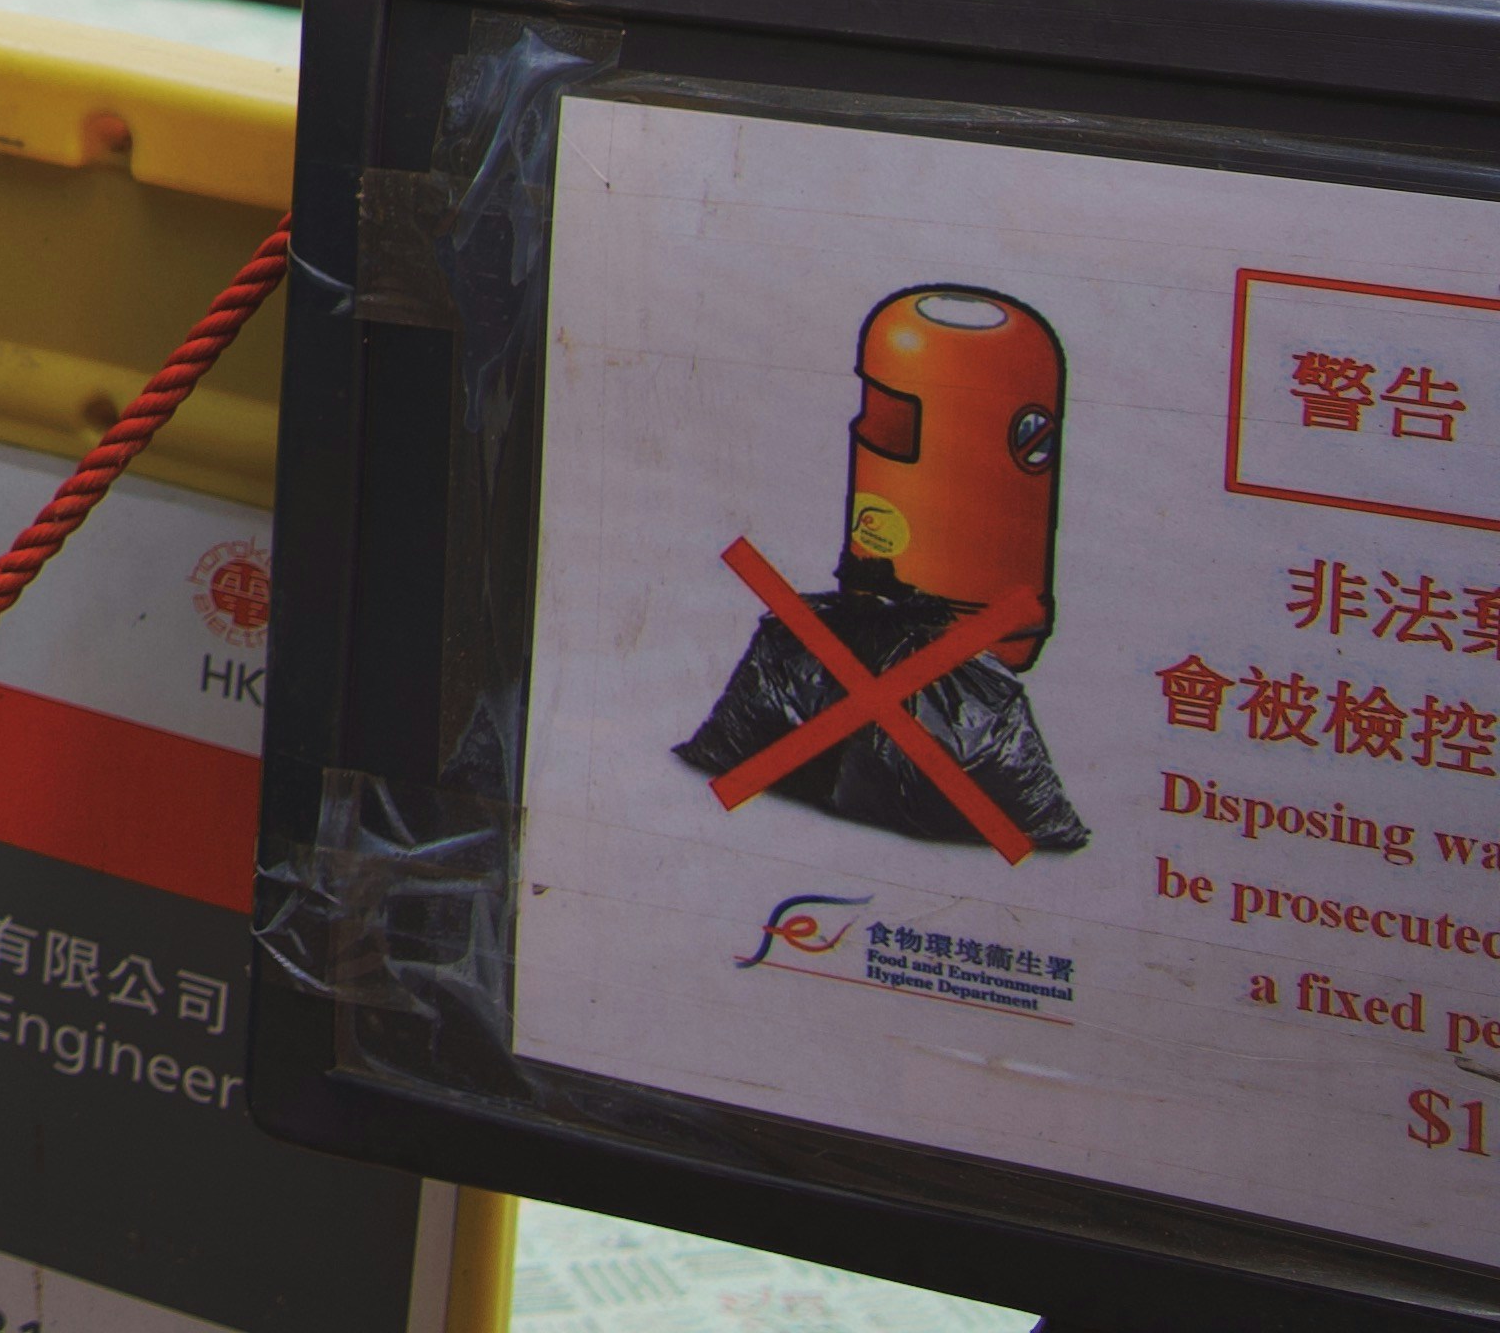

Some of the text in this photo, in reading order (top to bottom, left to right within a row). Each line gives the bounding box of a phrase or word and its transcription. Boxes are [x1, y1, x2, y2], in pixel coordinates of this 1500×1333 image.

[1290, 351, 1467, 442] 警告
[201, 653, 265, 708] HK
[1155, 654, 1498, 777] 會被檢控
[1159, 771, 1416, 865] Disposing
[1156, 856, 1214, 903] be
[866, 948, 1074, 1001] Food and Environmental
[866, 965, 1039, 1011] Hygiene Department
[1250, 974, 1278, 1004] a
[1296, 972, 1426, 1033] fixed
[1407, 1088, 1491, 1158] $1
